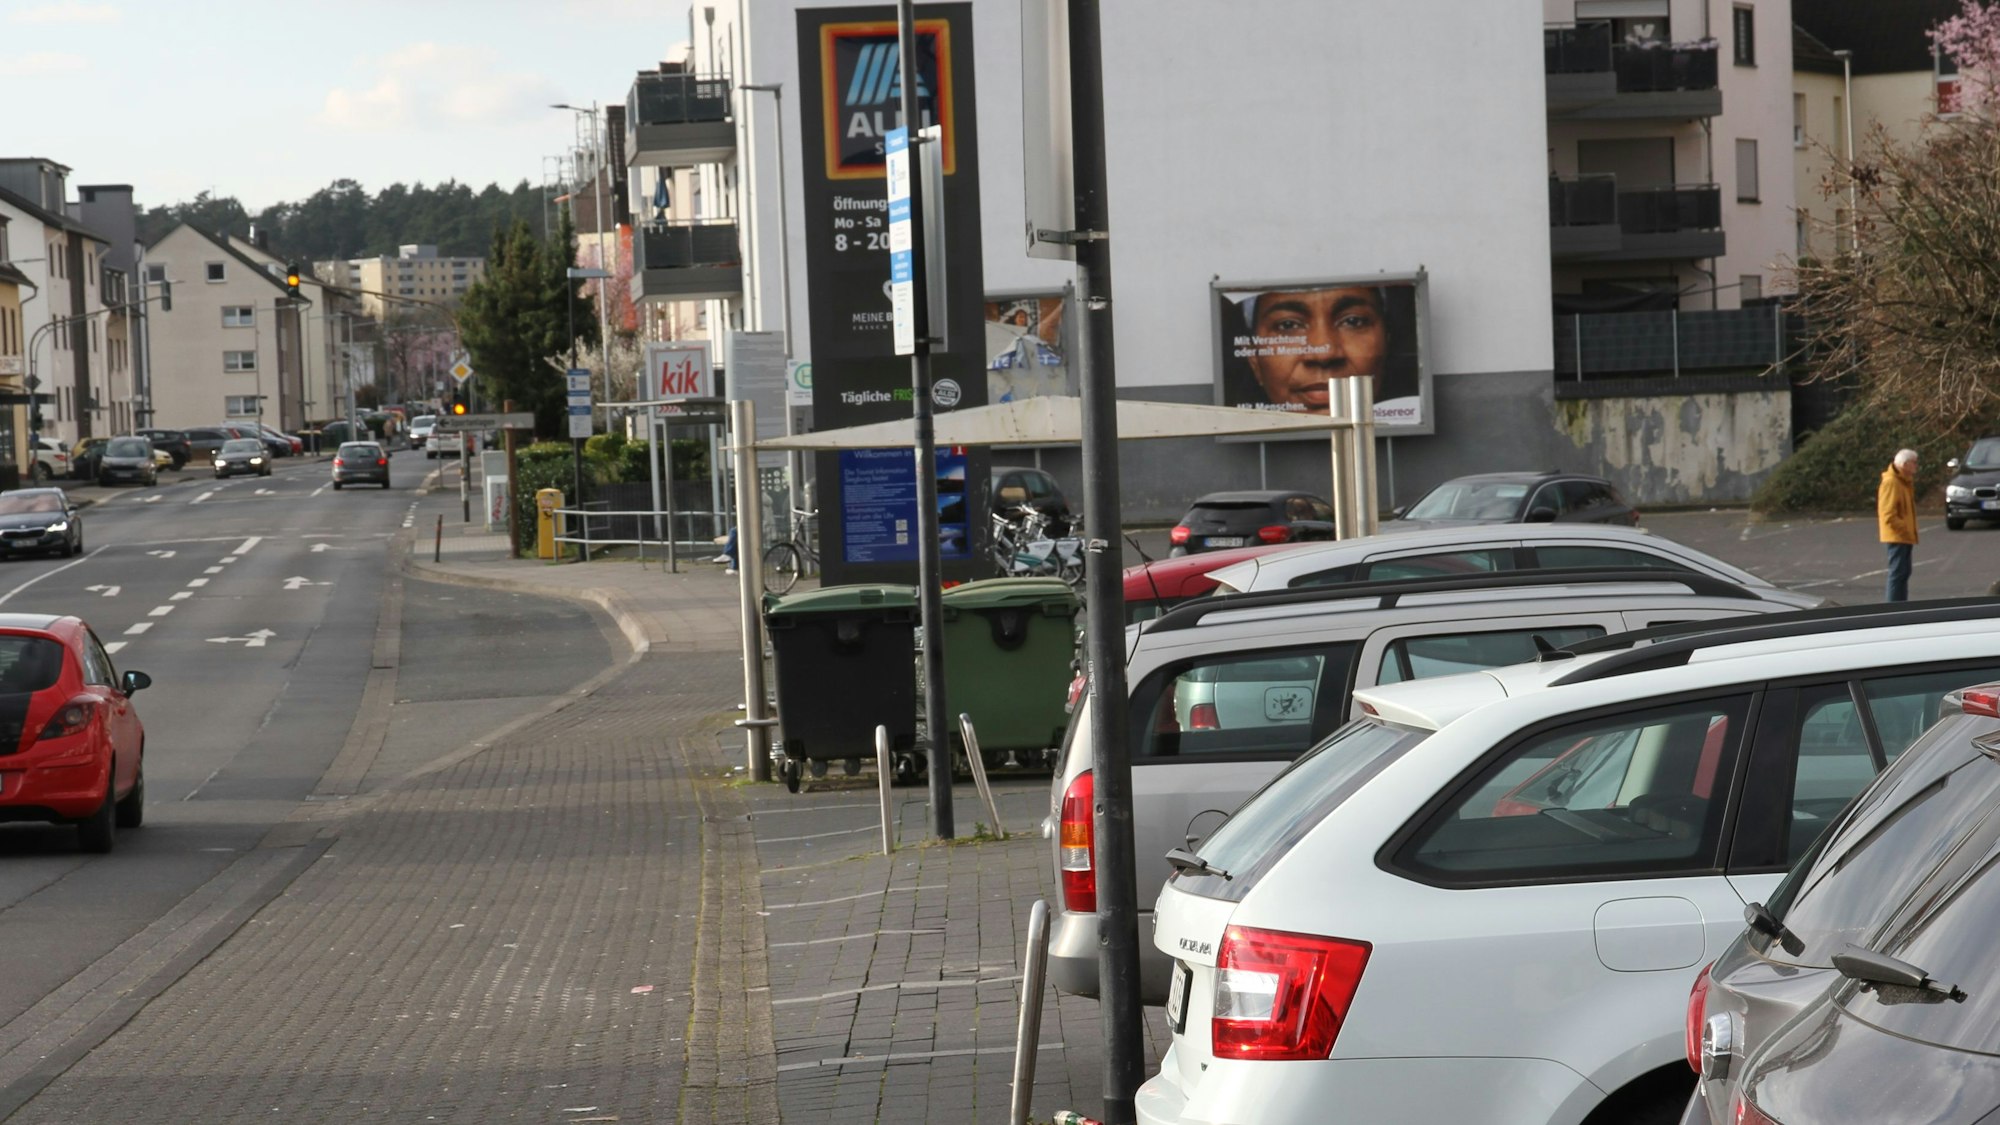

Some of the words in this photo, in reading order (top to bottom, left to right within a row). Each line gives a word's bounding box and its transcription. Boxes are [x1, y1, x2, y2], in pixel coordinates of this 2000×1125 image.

[847, 110, 931, 138] ALI
[833, 196, 888, 211] Öffnung
[834, 217, 855, 228] Mo
[865, 216, 882, 228] Sa
[835, 233, 848, 251] 8
[867, 232, 890, 250] 20
[852, 312, 884, 323] MEINE
[1234, 335, 1250, 346] Mit
[1252, 335, 1307, 346] Verachtung
[1234, 347, 1256, 357] oder
[1258, 346, 1274, 356] mit
[1276, 344, 1330, 356] Menschen?
[840, 390, 892, 405] Tägliche
[893, 388, 913, 401] FRIS
